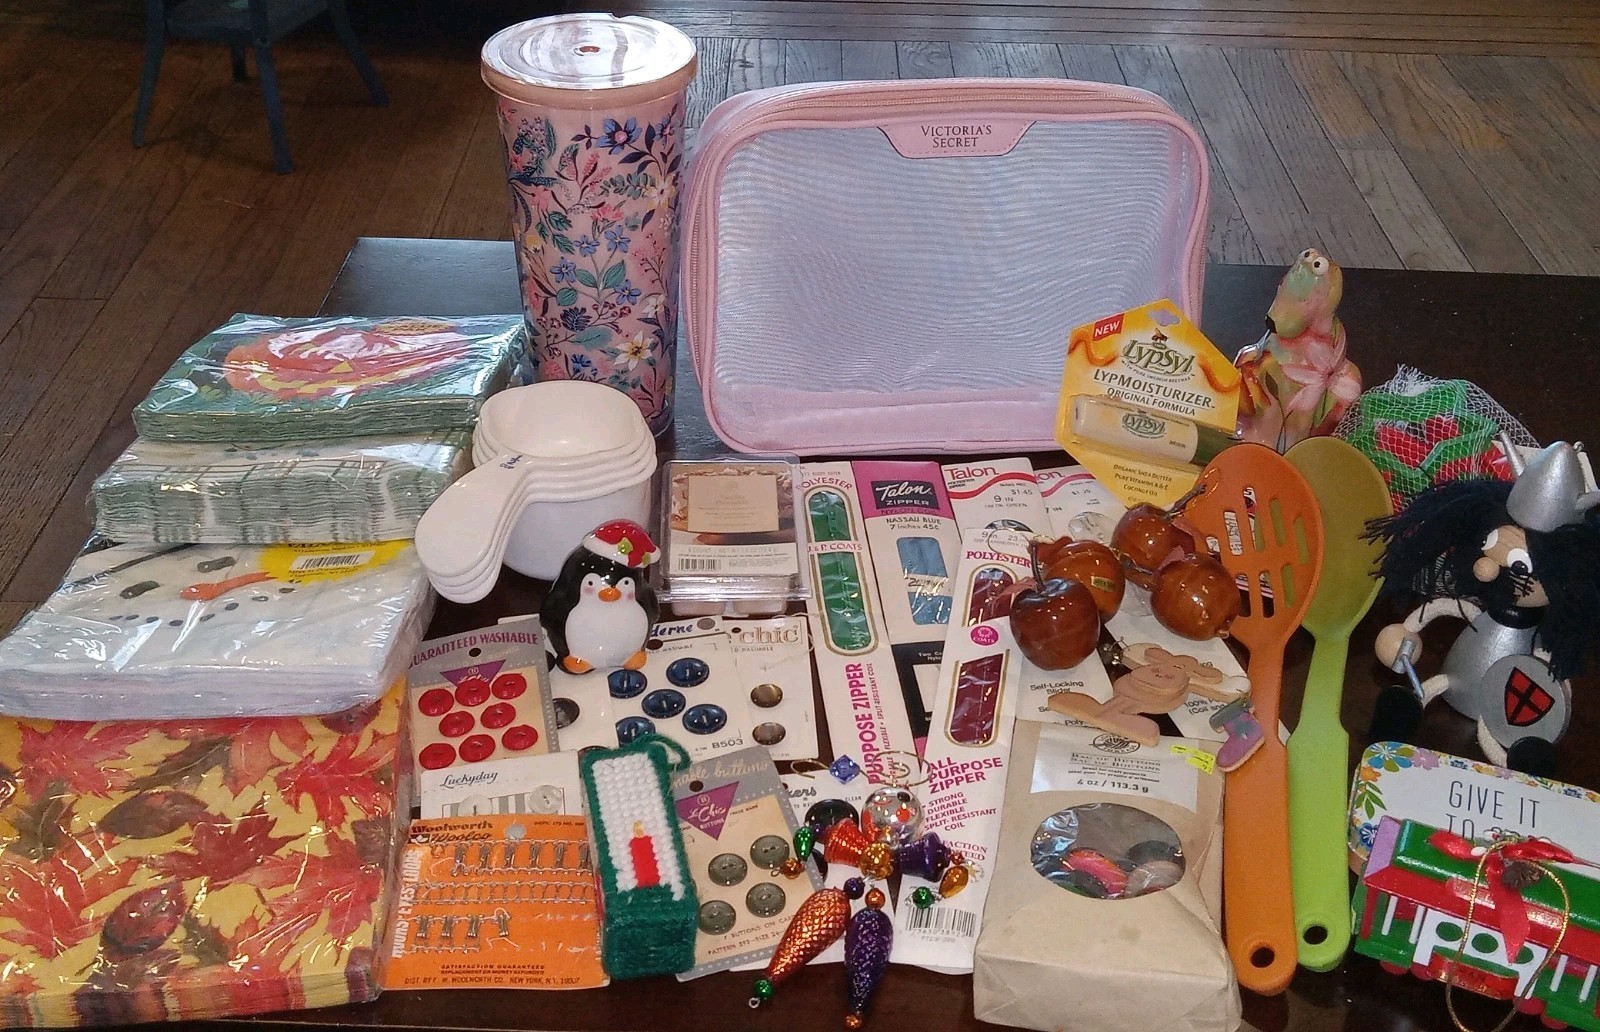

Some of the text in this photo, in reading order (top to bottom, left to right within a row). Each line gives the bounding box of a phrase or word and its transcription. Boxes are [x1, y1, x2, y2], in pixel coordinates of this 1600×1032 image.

[921, 124, 992, 137] VICTORIA'S
[932, 136, 979, 148] SECRET
[1094, 320, 1121, 338] NEW
[1107, 386, 1151, 405] ORIGINAL
[1151, 398, 1196, 416] FORMULA
[944, 466, 997, 481] Talon
[1113, 463, 1138, 475] ORGANIC
[1151, 472, 1173, 483] BUTTER
[1123, 483, 1150, 495] COCONUT
[1129, 476, 1154, 488] VITAMINS
[875, 481, 932, 502] Talon
[993, 494, 1002, 502] 9
[885, 499, 930, 507] ZIPPER
[886, 516, 941, 525] NASSAU BLUE
[829, 543, 863, 551] COATS
[966, 550, 1031, 569] POLYESTER
[650, 623, 694, 637] derne
[739, 624, 799, 644] chic
[479, 631, 539, 645] WASHABLE
[1029, 680, 1085, 691] Self-Locking
[845, 662, 886, 784] PURPOSE ZIPPER
[711, 738, 744, 750] B503
[927, 756, 957, 773] ALL
[929, 757, 1004, 784] PURPOSE
[439, 771, 500, 789] Luckyday
[928, 771, 987, 795] ZIPPER
[1076, 778, 1084, 786] 4
[1110, 780, 1139, 791] 113.3
[927, 797, 968, 815] DURABLE
[928, 791, 965, 807] STRONG
[1448, 780, 1540, 829] GIVE IT
[698, 802, 727, 822] Chic
[925, 806, 966, 823] FLEXIBLE
[951, 808, 998, 822] RESISTANT
[411, 820, 494, 834] Woolworth
[700, 817, 725, 829] BUTTONS
[944, 822, 966, 832] COIL
[430, 832, 492, 843] Woolco
[731, 925, 762, 938] BUTTONS
[707, 943, 737, 955] PATTERN
[451, 976, 492, 984] WOOLWORTH
[509, 976, 524, 984] NEW
